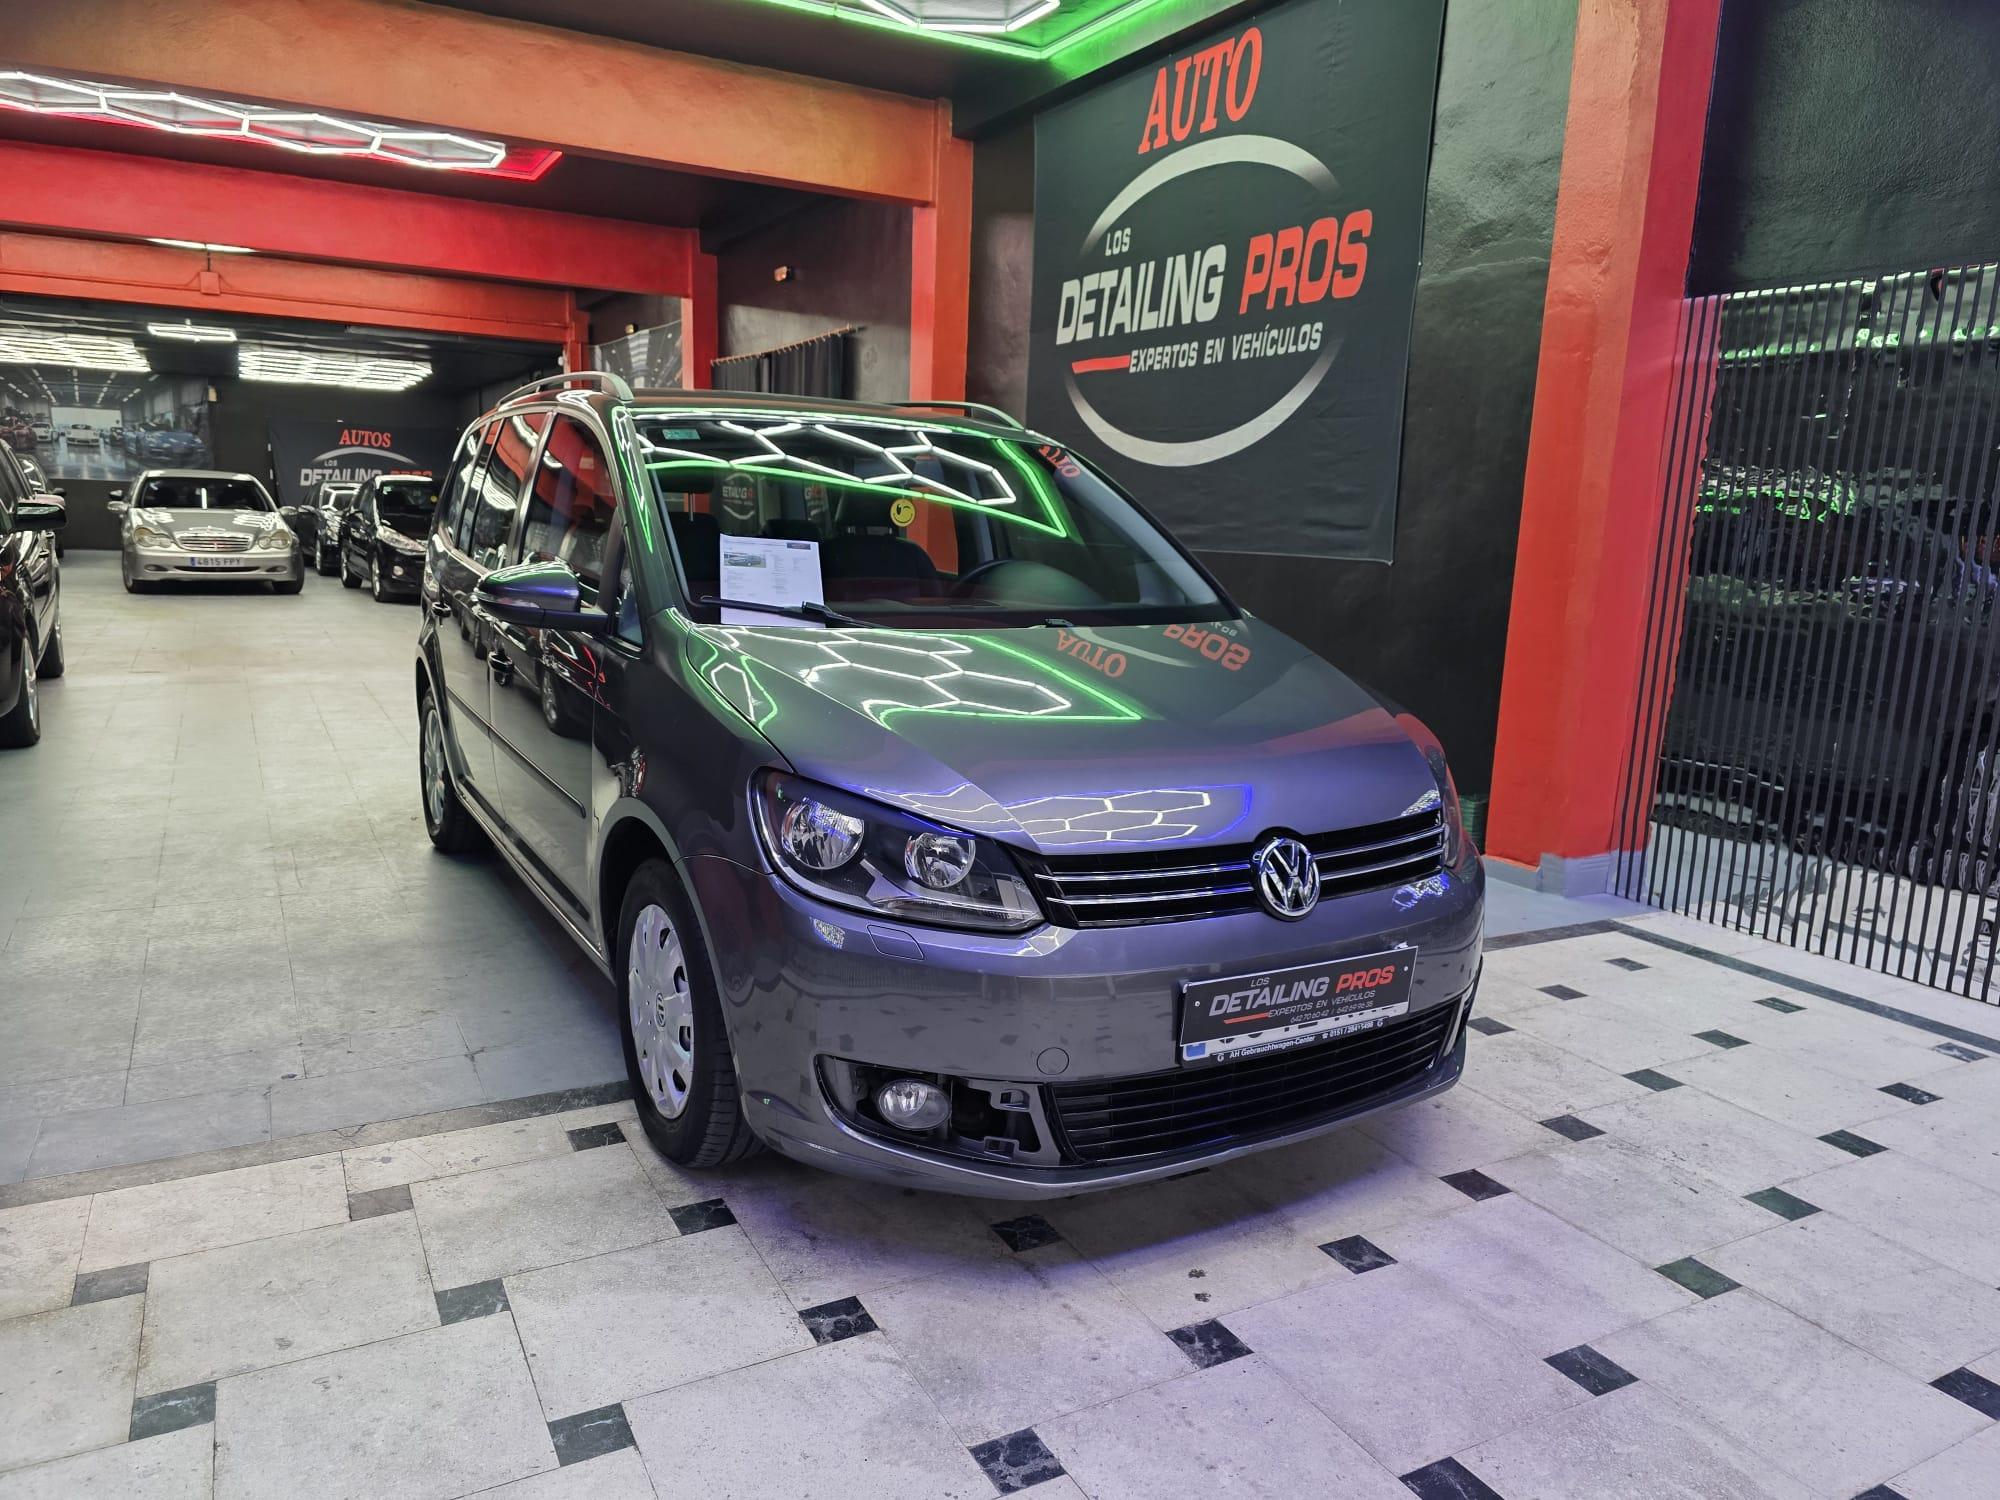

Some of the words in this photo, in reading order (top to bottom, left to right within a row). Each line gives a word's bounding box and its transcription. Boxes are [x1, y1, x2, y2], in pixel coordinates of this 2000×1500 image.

[1137, 26, 1263, 155] AUTO
[1104, 227, 1132, 257] LOS
[1055, 243, 1227, 346] DETAILING
[1239, 208, 1373, 315] PROS
[1129, 341, 1199, 374] EXPERTOS
[1203, 335, 1226, 366] EN
[1232, 321, 1324, 361] VEHÍCULOS
[339, 429, 392, 448] AUTOS
[1208, 976, 1330, 1017] DETAILING
[1335, 965, 1395, 994] PROS
[1250, 977, 1270, 988] LOS
[1268, 1002, 1314, 1018] EXPERTOS
[1315, 999, 1329, 1009] EN
